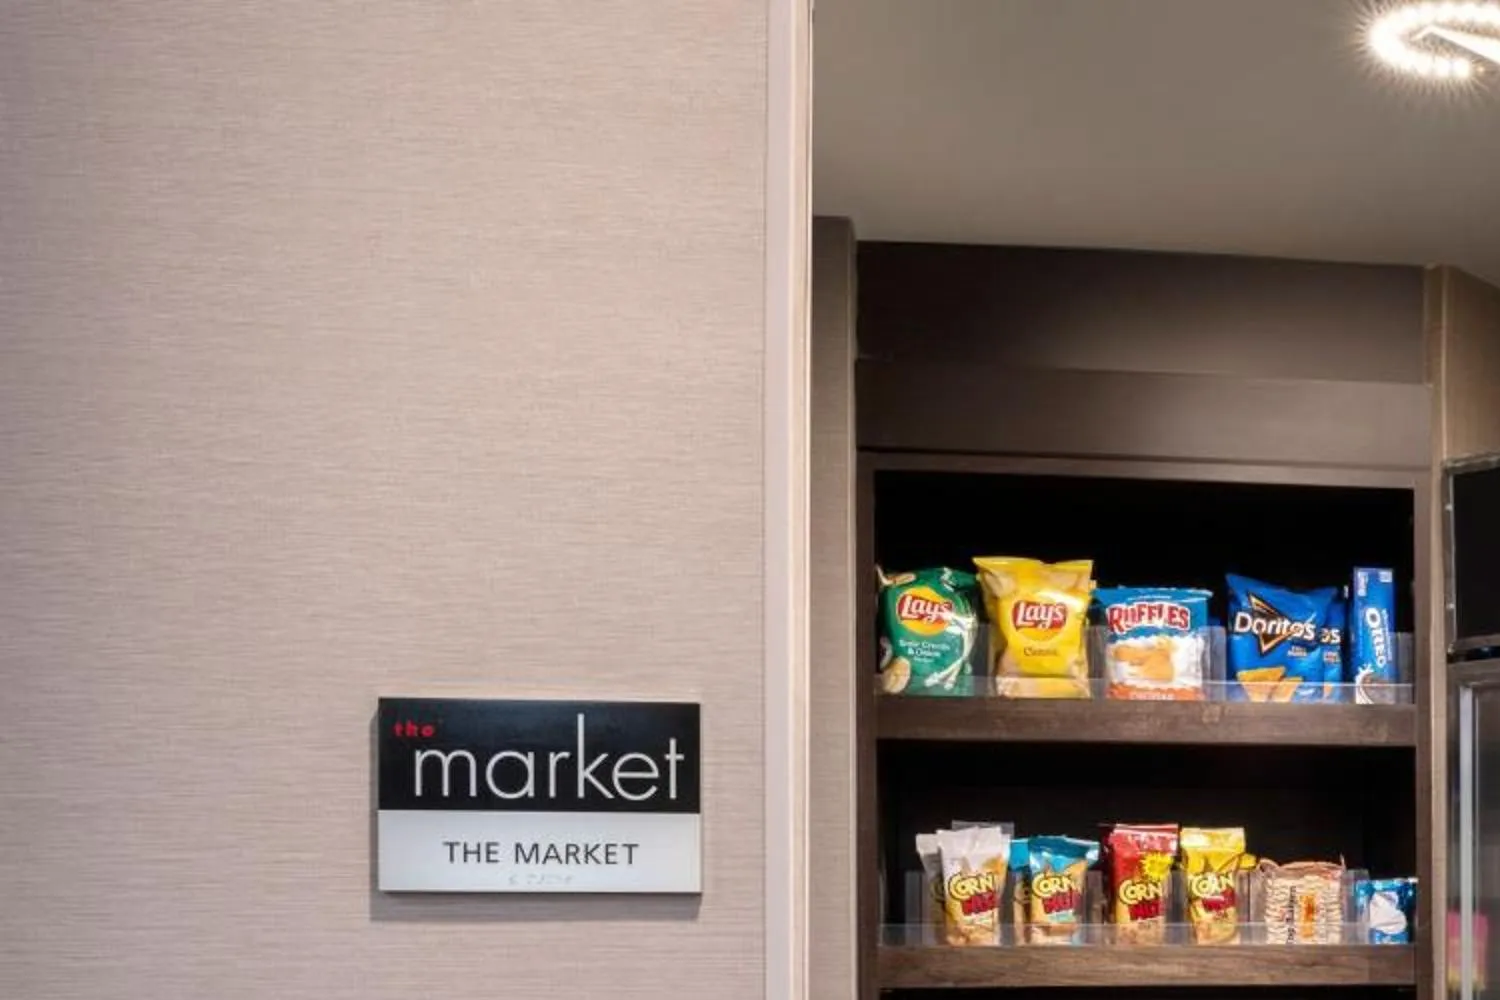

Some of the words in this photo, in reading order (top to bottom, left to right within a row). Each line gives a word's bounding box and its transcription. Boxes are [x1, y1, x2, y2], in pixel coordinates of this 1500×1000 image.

[1107, 602, 1190, 634] RUFFLES
[1234, 612, 1317, 641] Doritos
[393, 720, 435, 737] the
[415, 713, 685, 801] market
[442, 841, 500, 864] THE
[514, 842, 639, 866] MARKET
